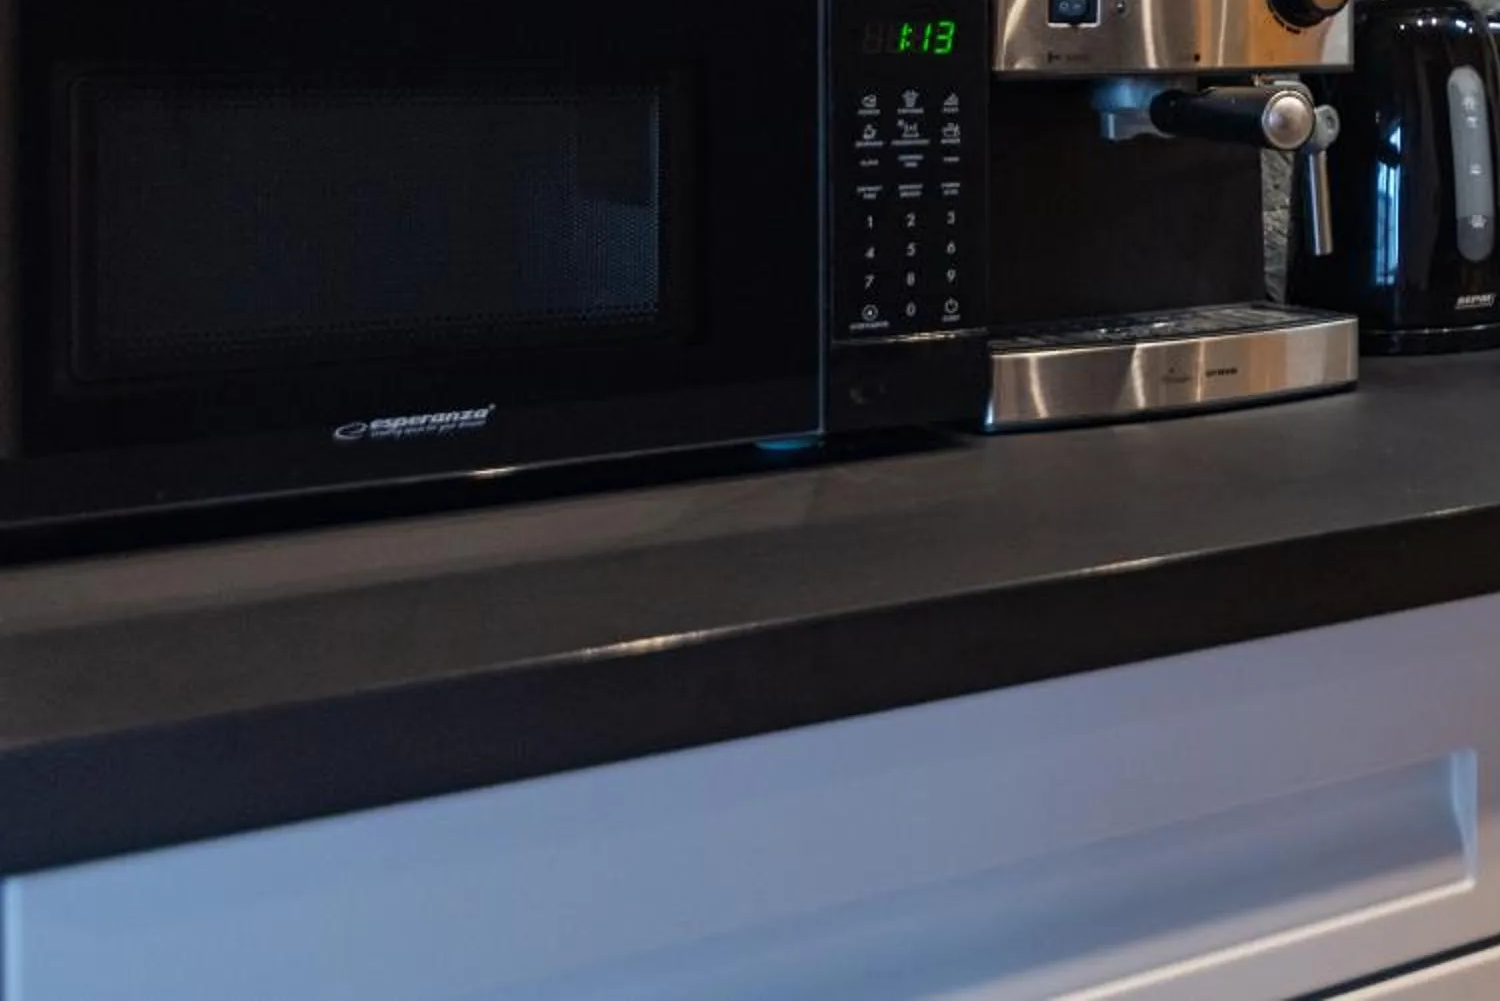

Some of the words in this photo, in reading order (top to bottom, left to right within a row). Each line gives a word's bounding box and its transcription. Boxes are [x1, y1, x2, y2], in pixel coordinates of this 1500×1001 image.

[899, 20, 955, 54] 1:13
[906, 212, 916, 228] 2
[946, 210, 956, 225] 3
[864, 246, 875, 259] 4
[906, 242, 916, 257] 5
[946, 240, 956, 254] 6
[864, 274, 875, 289] 7
[906, 272, 916, 287] 8
[946, 268, 957, 283] 9
[905, 301, 917, 317] 0
[368, 408, 489, 432] esperanza
